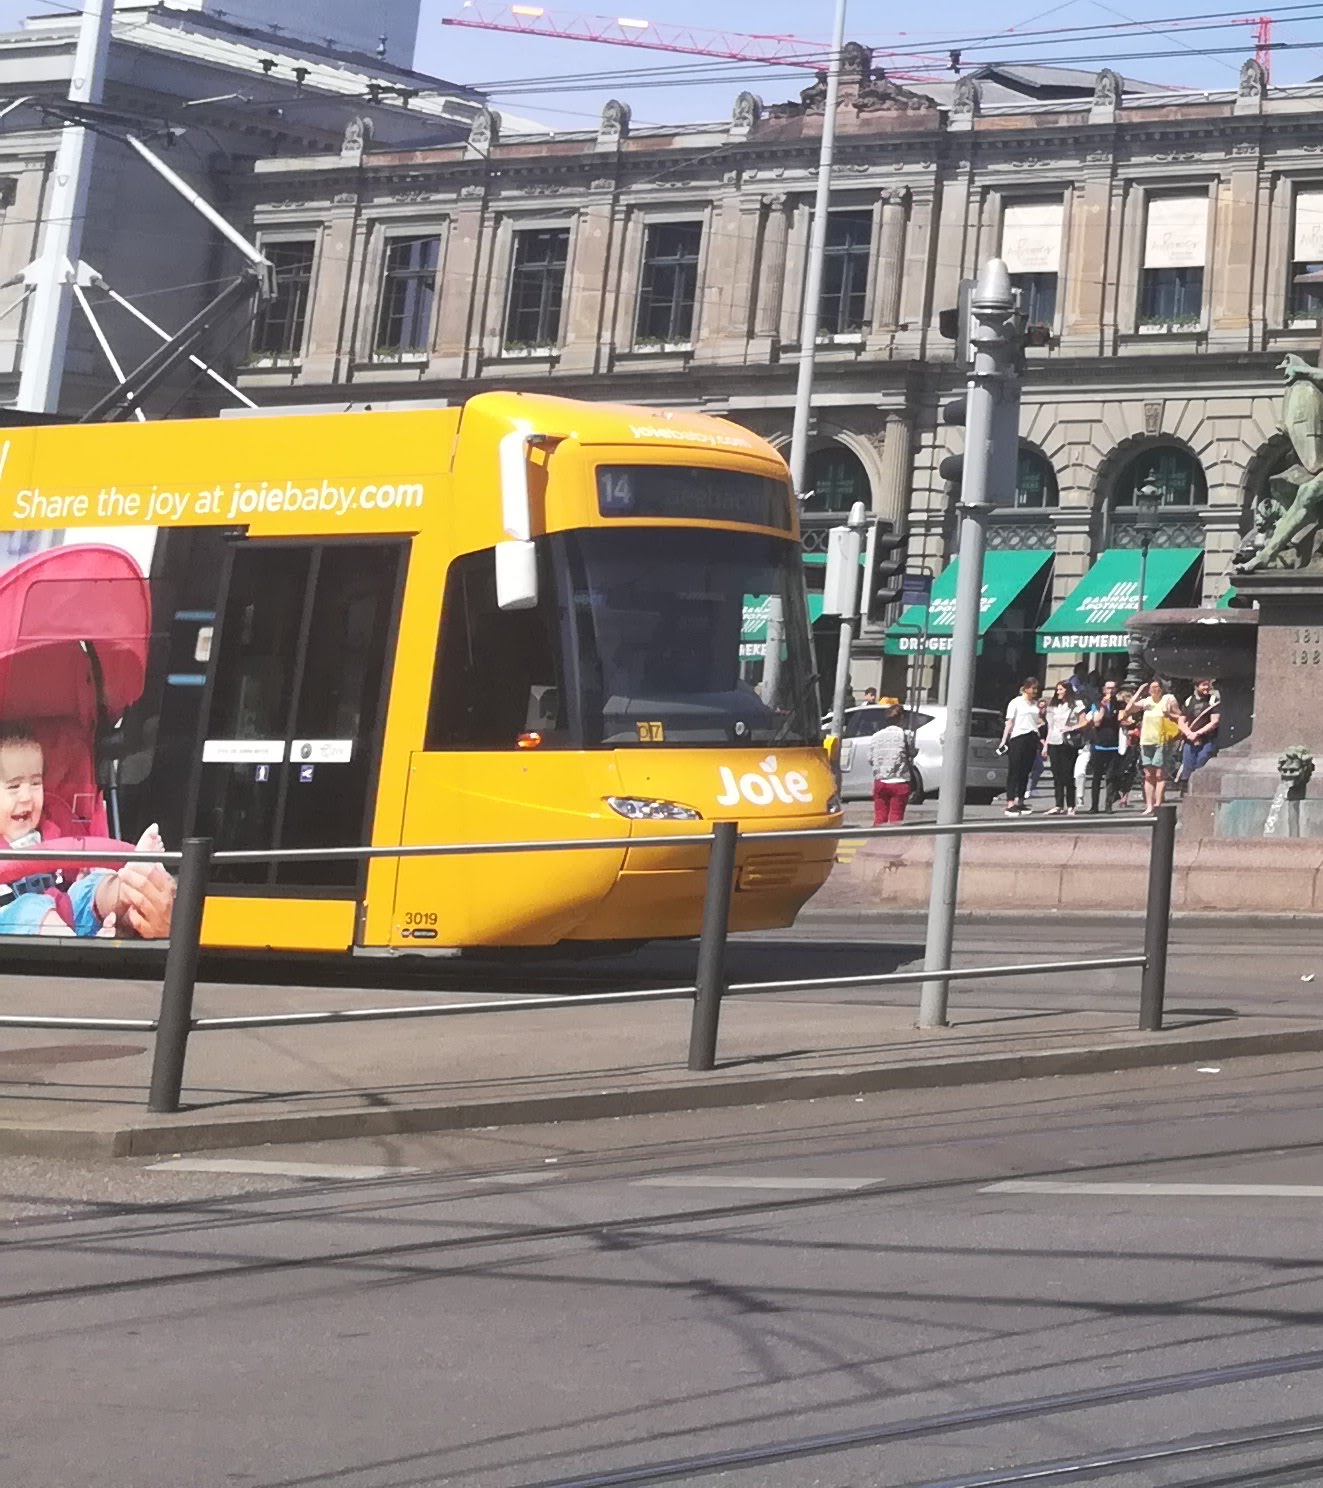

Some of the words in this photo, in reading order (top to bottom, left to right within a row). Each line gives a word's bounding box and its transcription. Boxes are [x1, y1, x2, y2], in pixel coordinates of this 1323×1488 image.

[13, 489, 89, 520] Share
[97, 486, 141, 518] the
[144, 485, 189, 521] joy
[194, 484, 225, 515] at
[227, 479, 424, 519] joiebaby.com
[601, 472, 633, 506] 14
[716, 754, 814, 807] Joie
[405, 911, 438, 925] 3019
